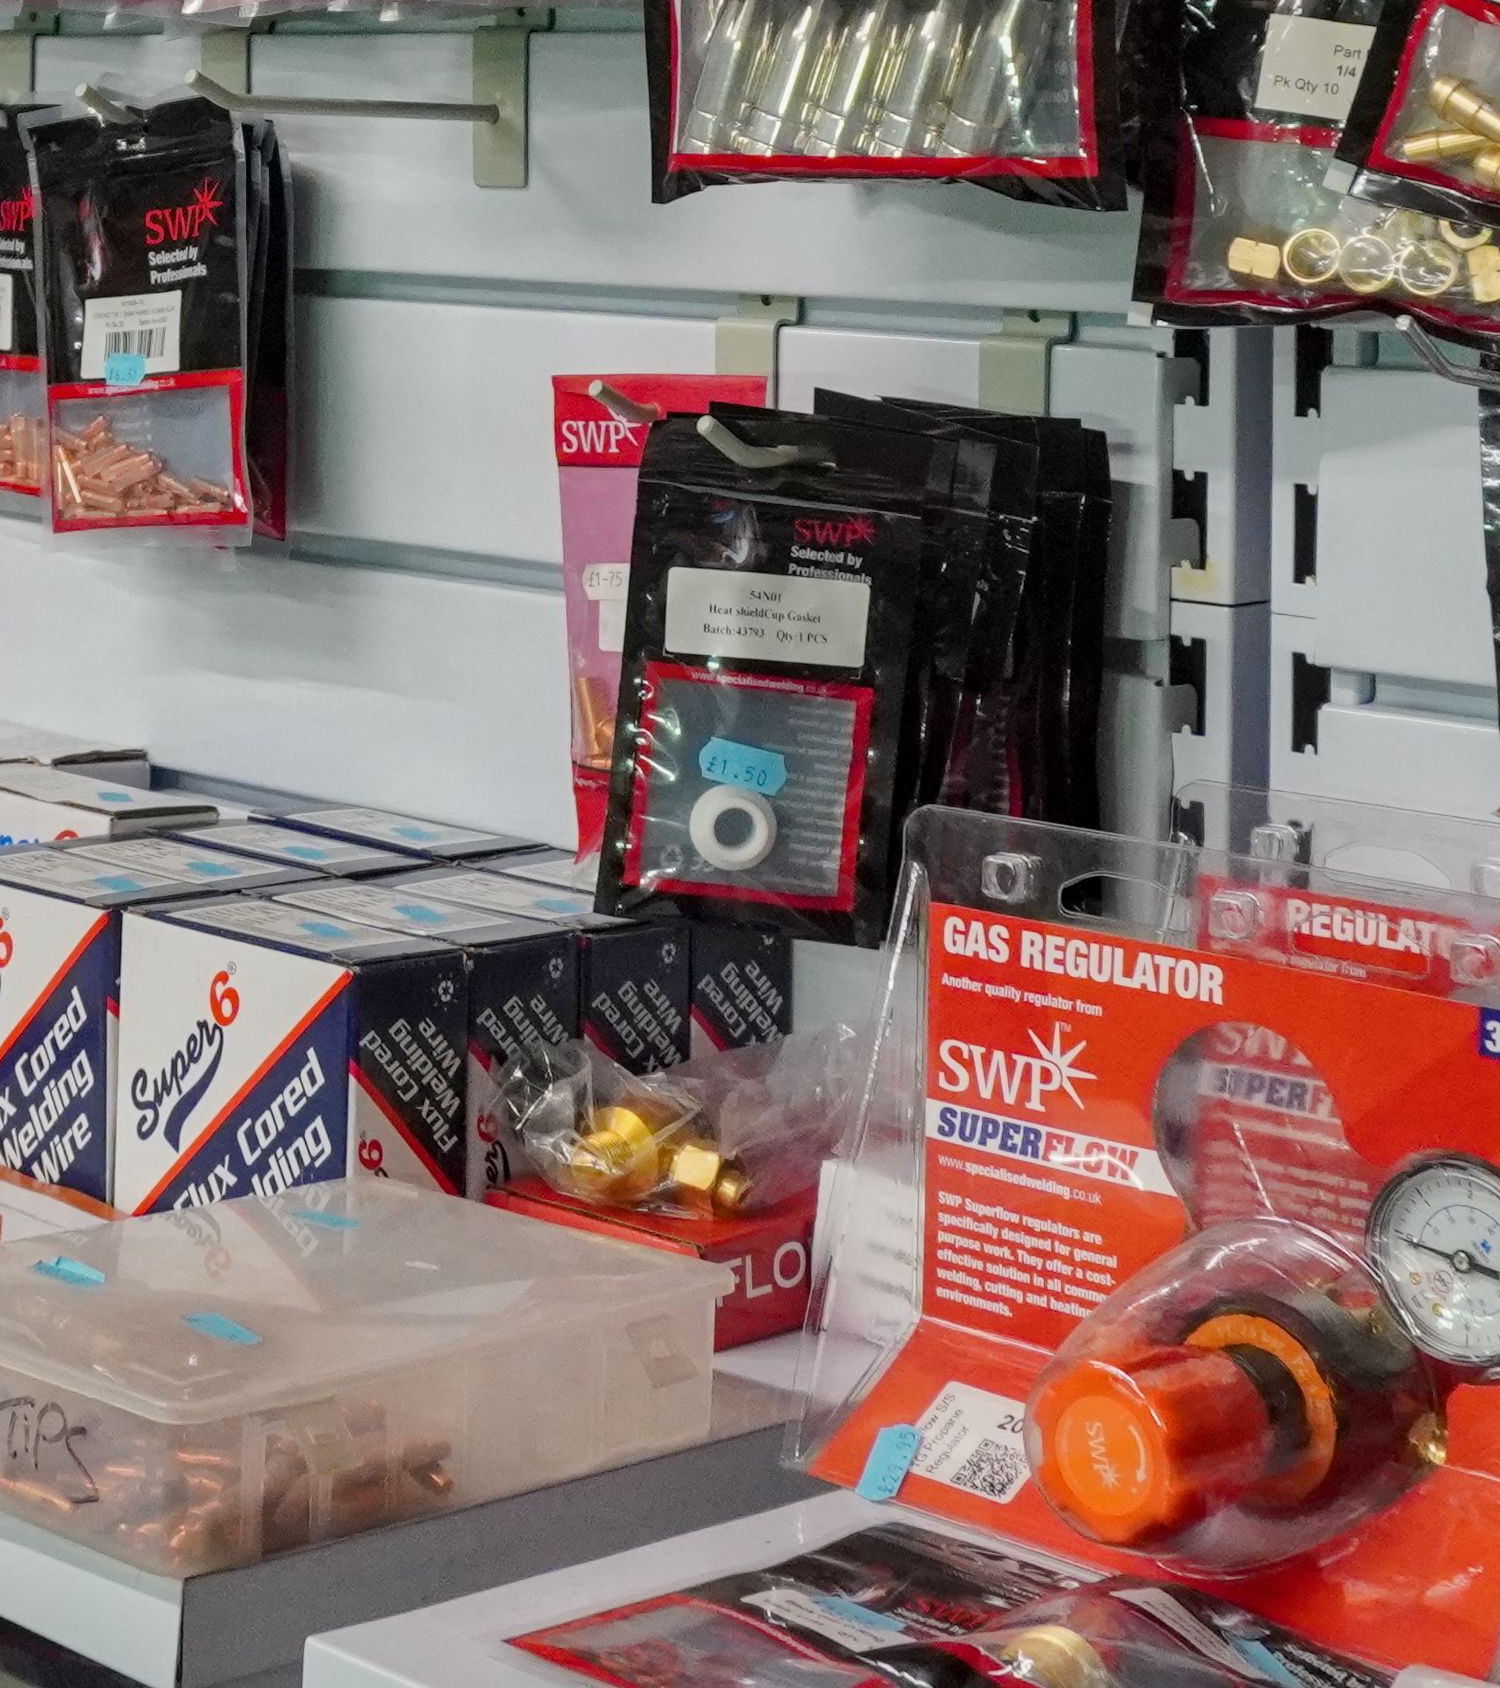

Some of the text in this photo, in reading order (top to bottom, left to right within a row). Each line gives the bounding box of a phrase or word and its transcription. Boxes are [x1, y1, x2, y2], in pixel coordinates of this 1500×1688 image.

[150, 262, 207, 285] Professionals
[561, 419, 626, 454] SWP
[791, 545, 863, 568] Selected by
[706, 757, 767, 787] £1.50
[943, 916, 1010, 963] GAS
[1020, 929, 1224, 1006] REGULATOR
[941, 972, 1103, 1017] Another quality regulator from
[13, 985, 89, 1095] Cored
[938, 1039, 1065, 1112] SWP
[29, 1112, 93, 1186] Wire
[172, 1047, 326, 1213] Flux Cored
[937, 1106, 1140, 1181] SUPERFLOW
[938, 1156, 1102, 1205] www.specialisedwelding.co.uk
[938, 1191, 1102, 1245] SWP Superflow regulators are
[938, 1212, 1117, 1269] specifically designed for general
[938, 1230, 1116, 1286] purpose work. They offer a cost-
[936, 1286, 1013, 1317] environments.
